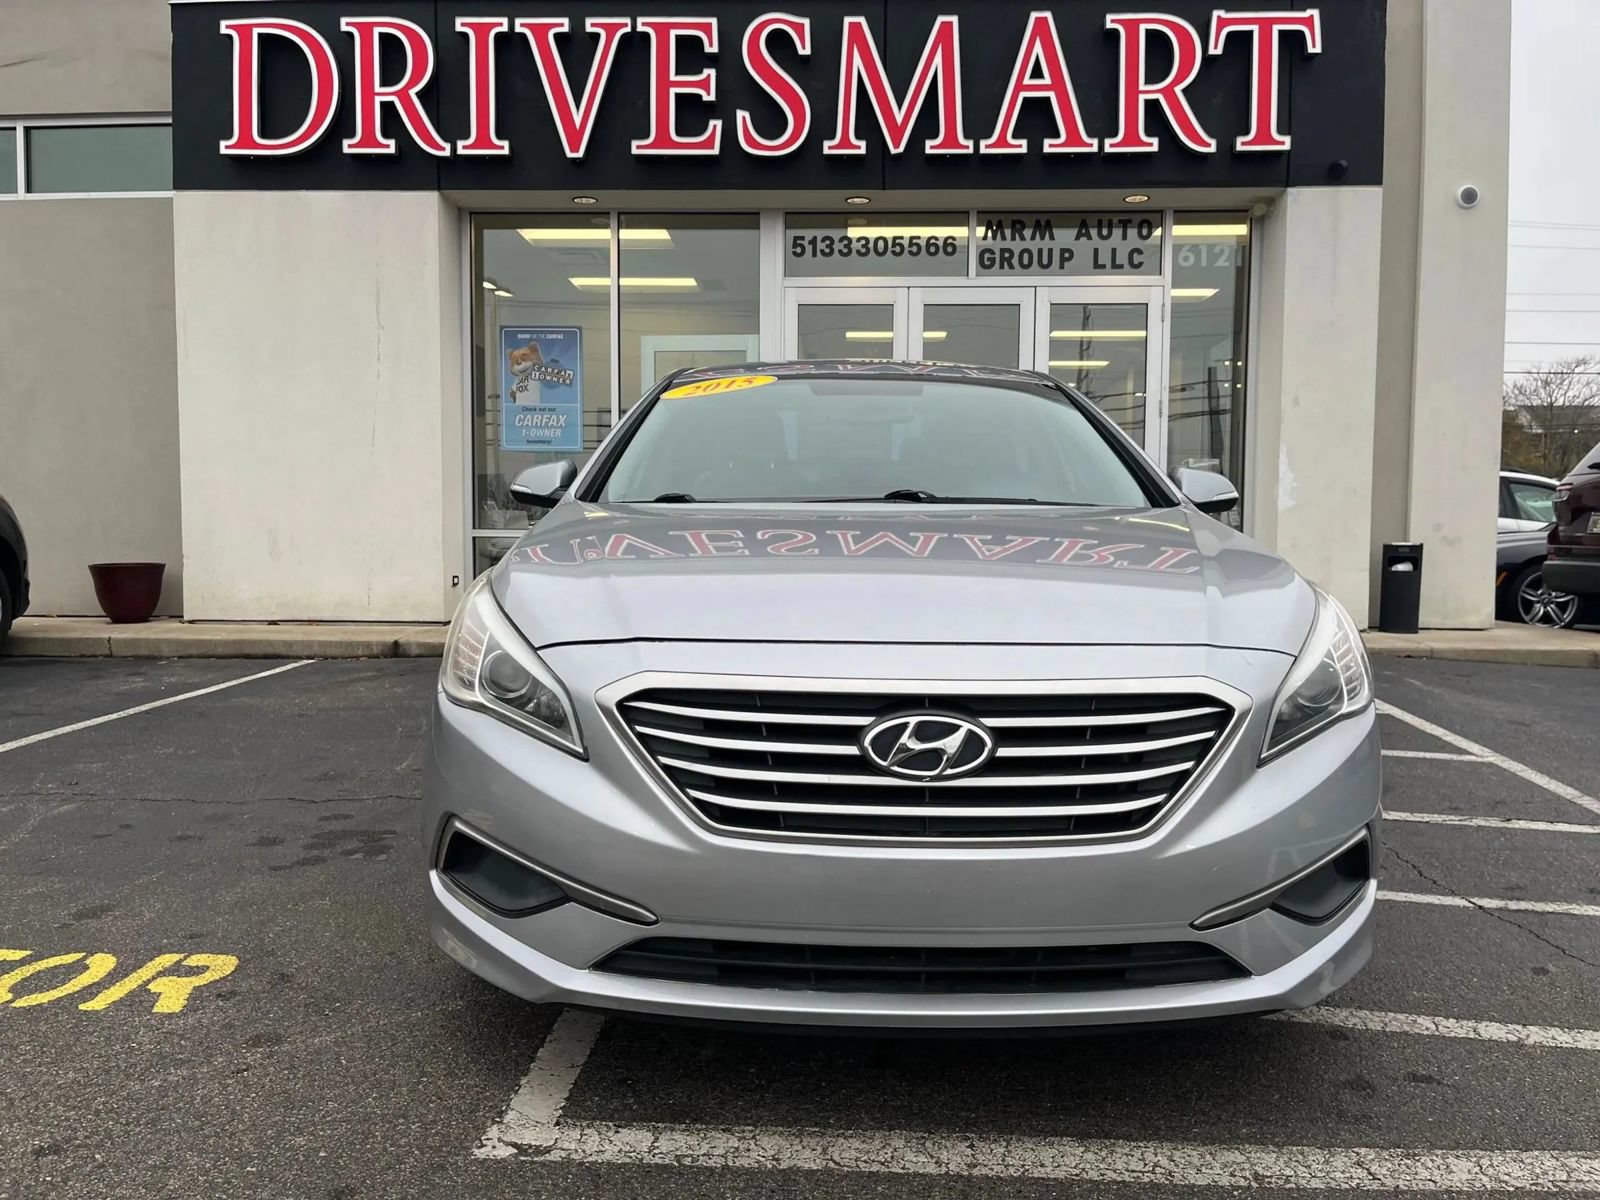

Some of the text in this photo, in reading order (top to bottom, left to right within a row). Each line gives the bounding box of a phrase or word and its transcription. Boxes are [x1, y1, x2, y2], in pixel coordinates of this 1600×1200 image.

[219, 9, 1322, 158] DRIVESMART
[982, 219, 1154, 241] MRM AUTO
[792, 235, 957, 258] 5133305566
[978, 247, 1144, 270] GROUP LLC
[534, 365, 574, 379] CARFAX
[681, 377, 757, 397] 2015
[515, 414, 567, 427] CARFAX
